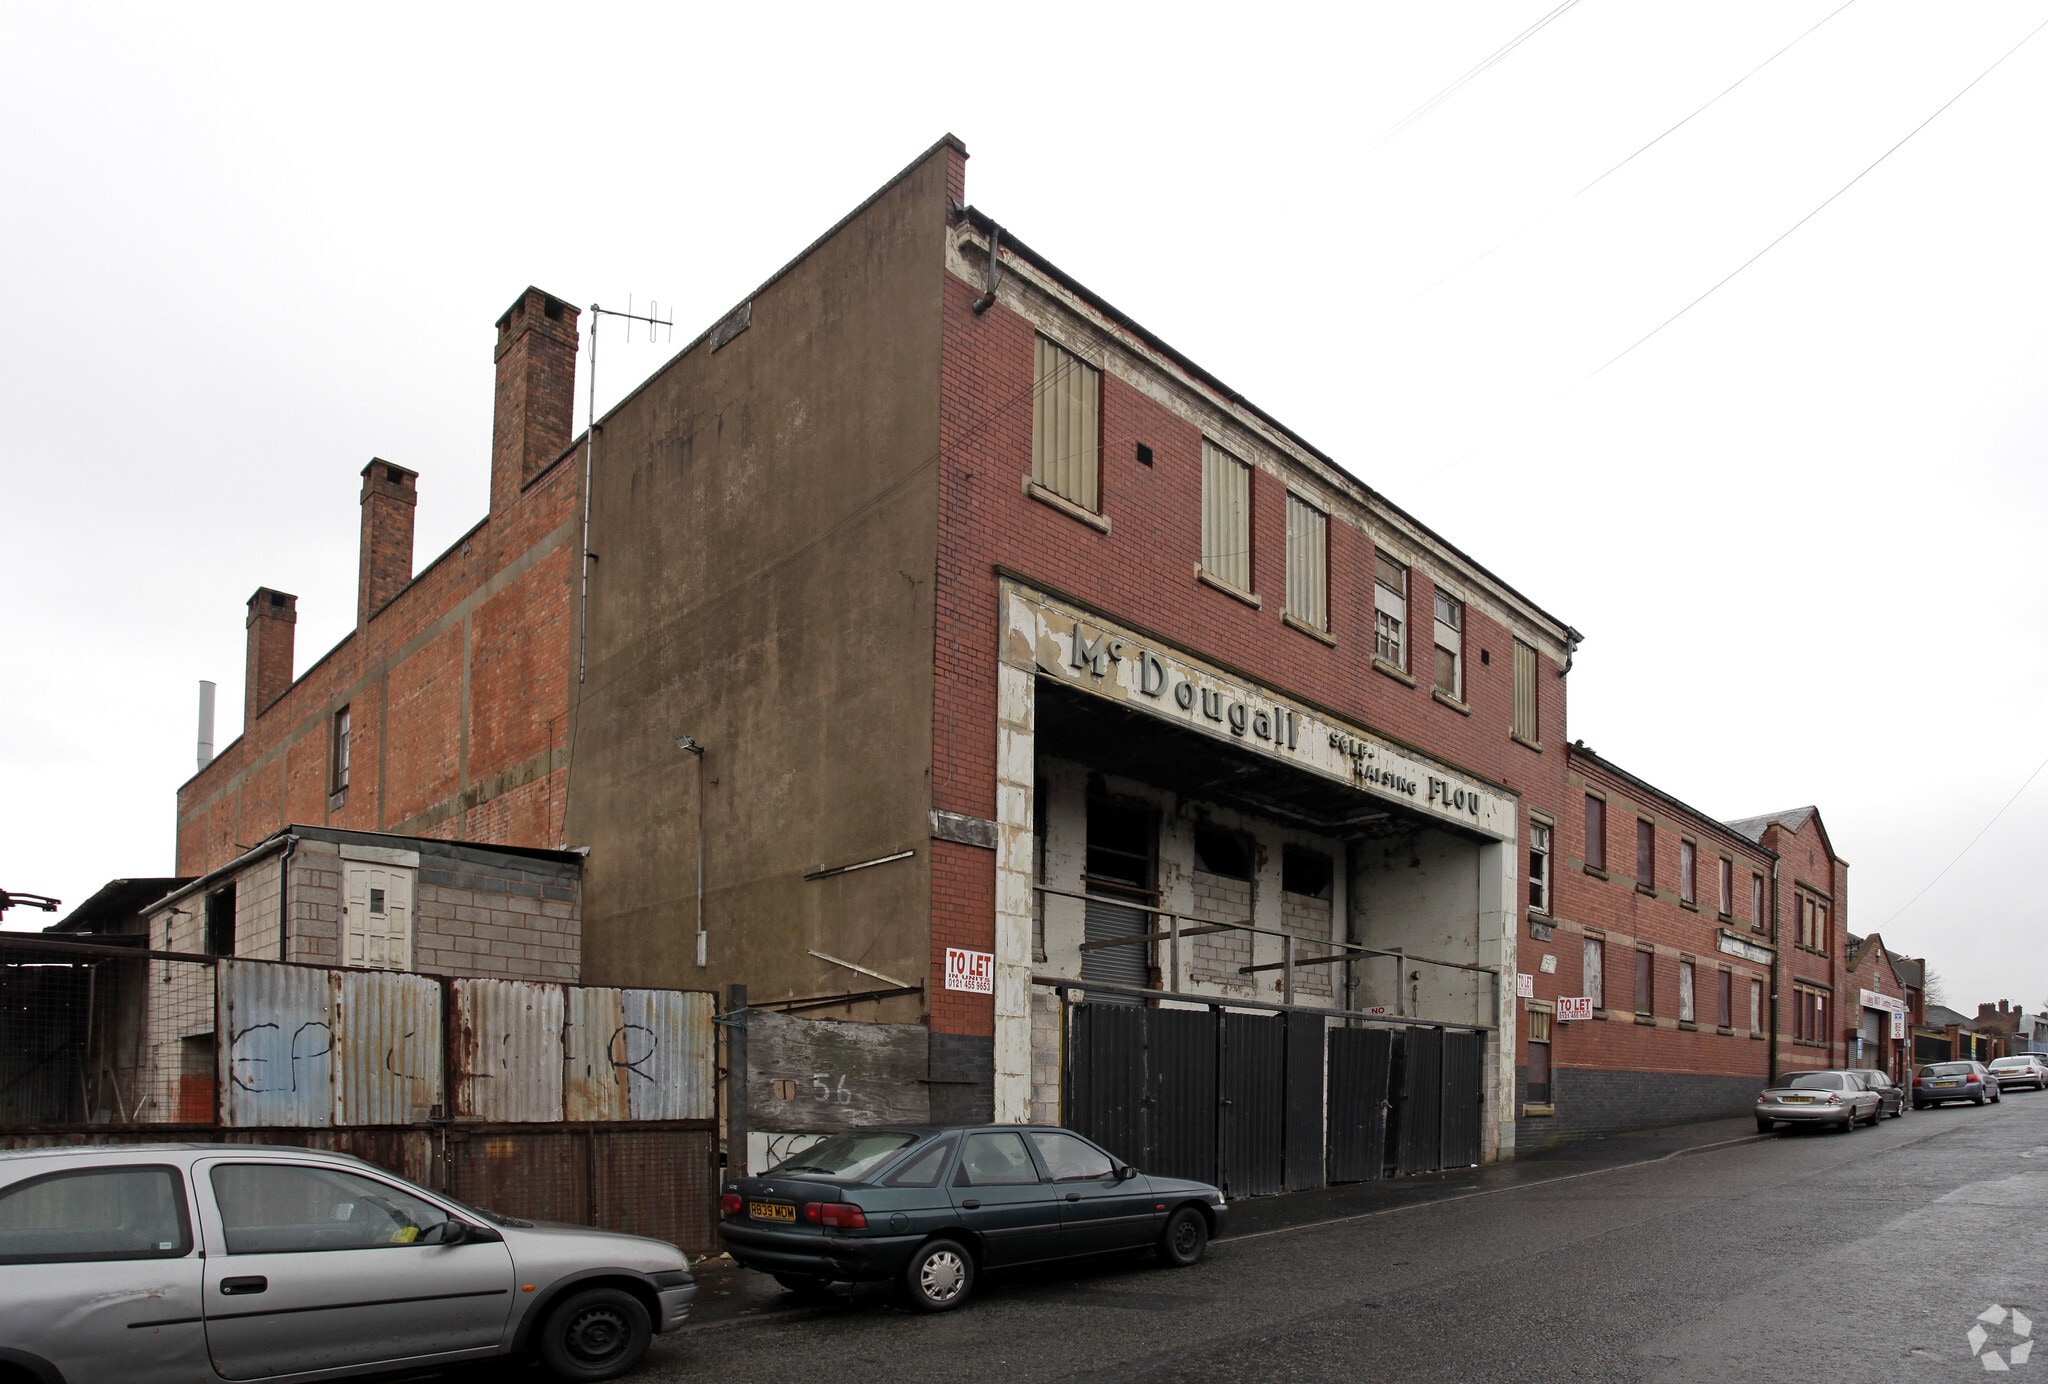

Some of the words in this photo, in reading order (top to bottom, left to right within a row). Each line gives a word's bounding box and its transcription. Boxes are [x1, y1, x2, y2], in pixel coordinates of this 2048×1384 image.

[1140, 650, 1298, 750] Dougall
[1353, 759, 1418, 796] RAISING
[949, 951, 965, 974] TO
[969, 953, 991, 978] LET
[948, 978, 962, 989] 0121
[964, 980, 975, 990] 455
[961, 974, 990, 983] UNITS
[1559, 999, 1571, 1011] TO
[1574, 998, 1590, 1011] LET
[751, 1203, 773, 1216] R839
